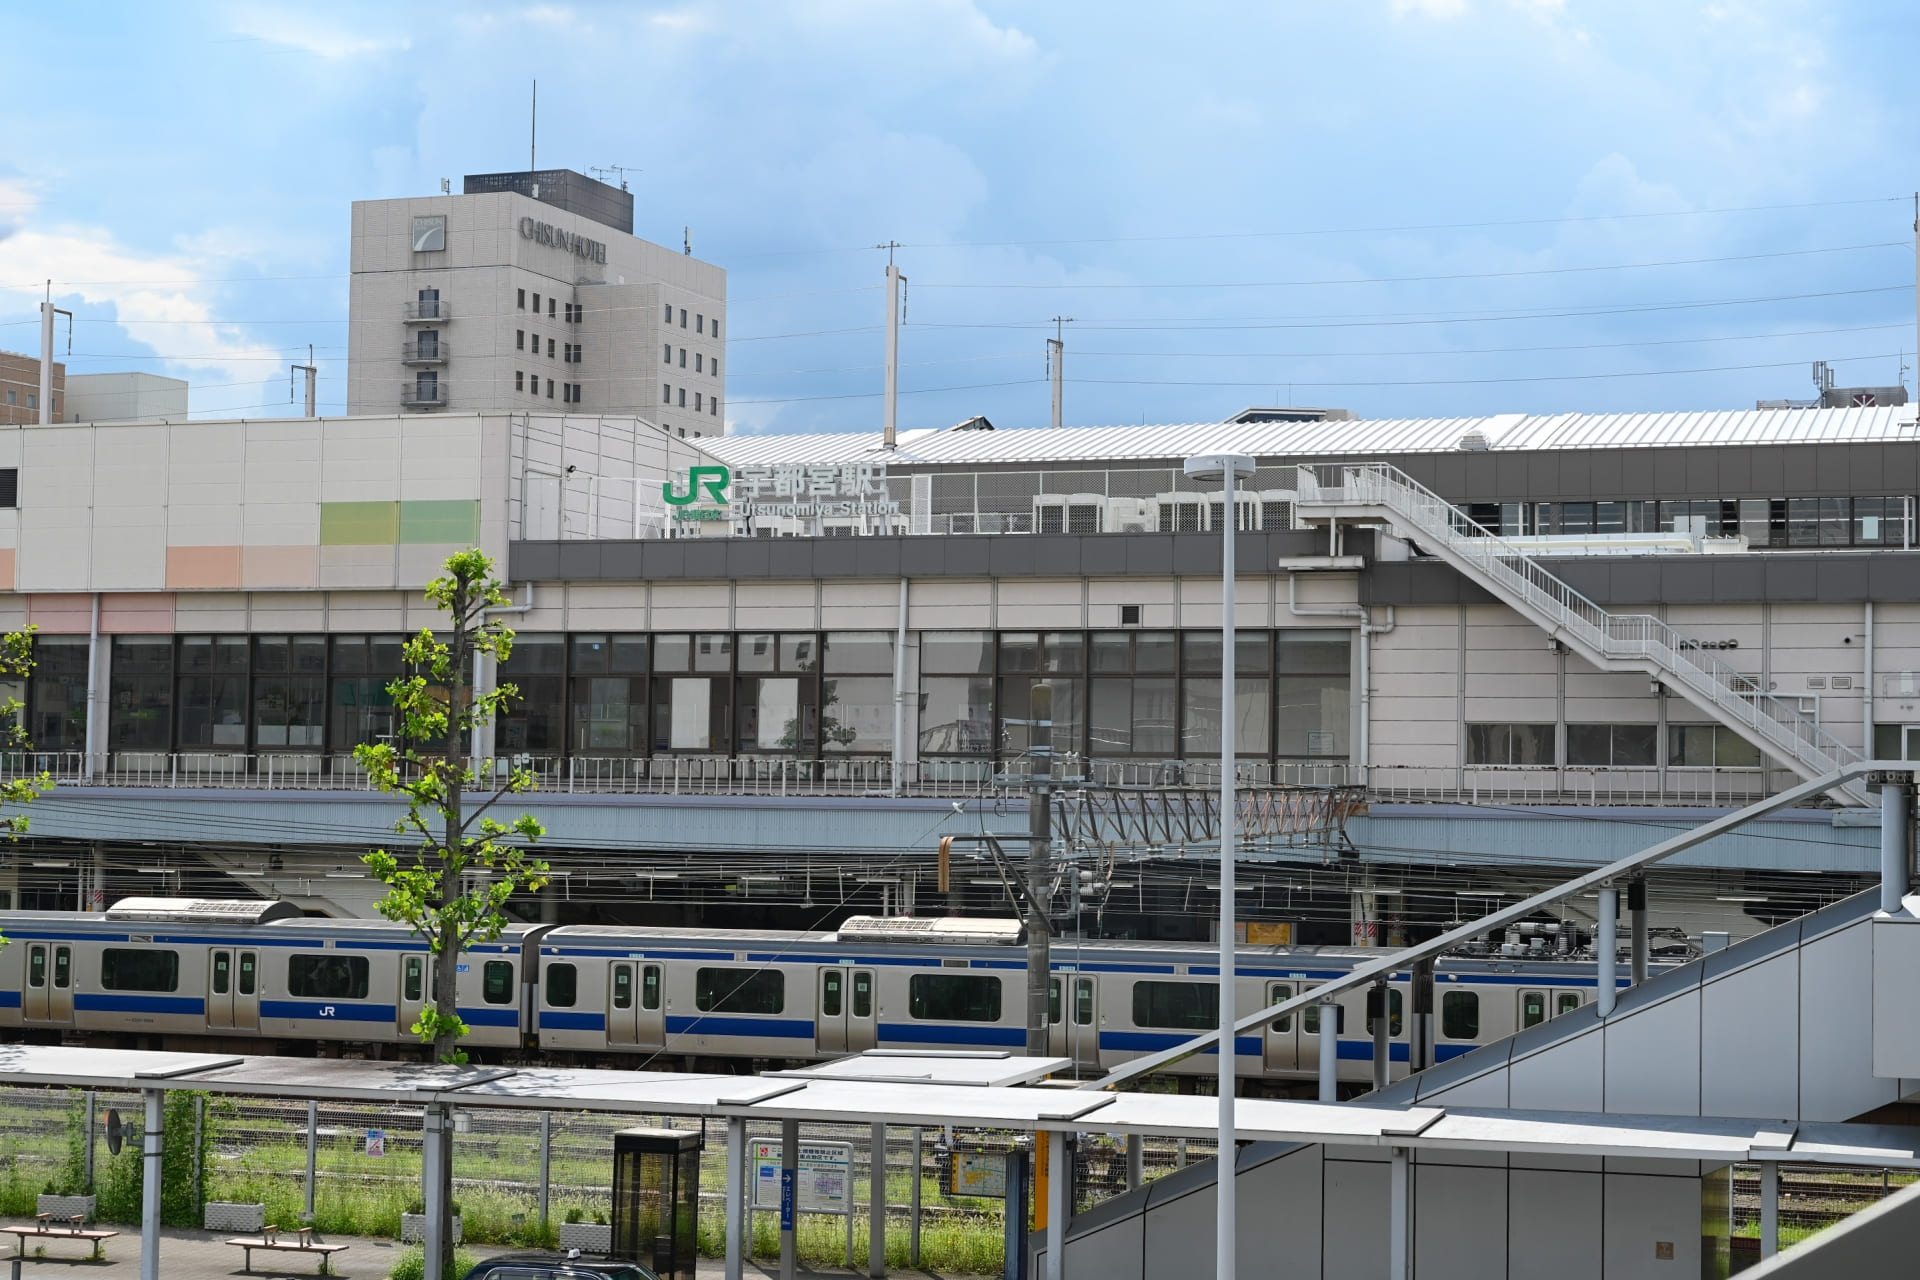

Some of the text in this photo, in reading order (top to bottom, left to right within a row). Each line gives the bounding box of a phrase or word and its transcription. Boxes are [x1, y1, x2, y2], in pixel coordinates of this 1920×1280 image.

[520, 216, 607, 264] CHISUN HOTEL
[663, 466, 729, 504] JR
[741, 464, 873, 497] 宇都宮駅
[672, 509, 721, 521] JR東日本
[739, 500, 898, 518] Utsunomiya Station
[319, 1006, 335, 1017] JR
